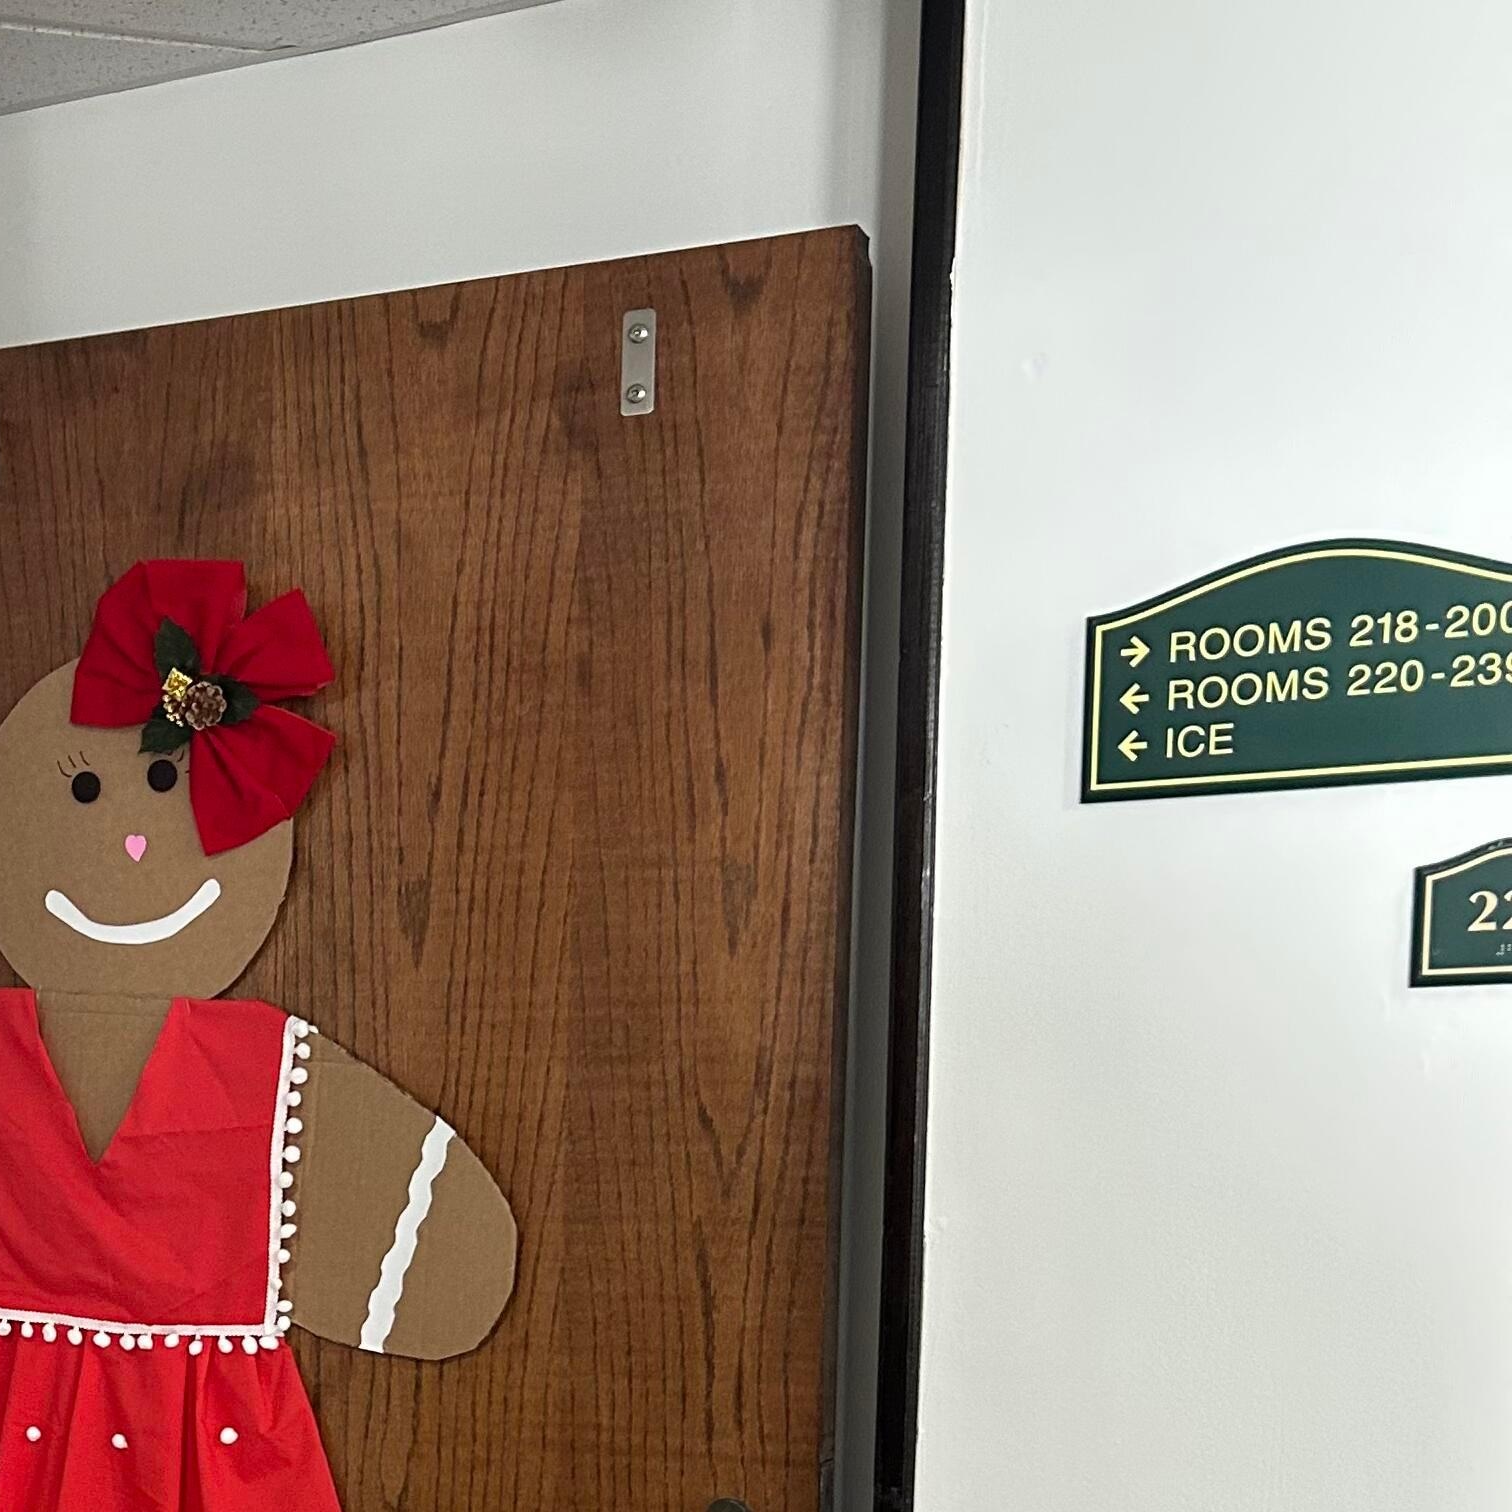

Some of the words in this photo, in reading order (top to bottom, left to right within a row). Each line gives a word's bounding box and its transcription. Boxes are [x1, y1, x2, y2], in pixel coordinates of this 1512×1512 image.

[1169, 617, 1332, 663] ROOMS
[1168, 666, 1329, 711] ROOMS
[1166, 722, 1234, 759] ICE
